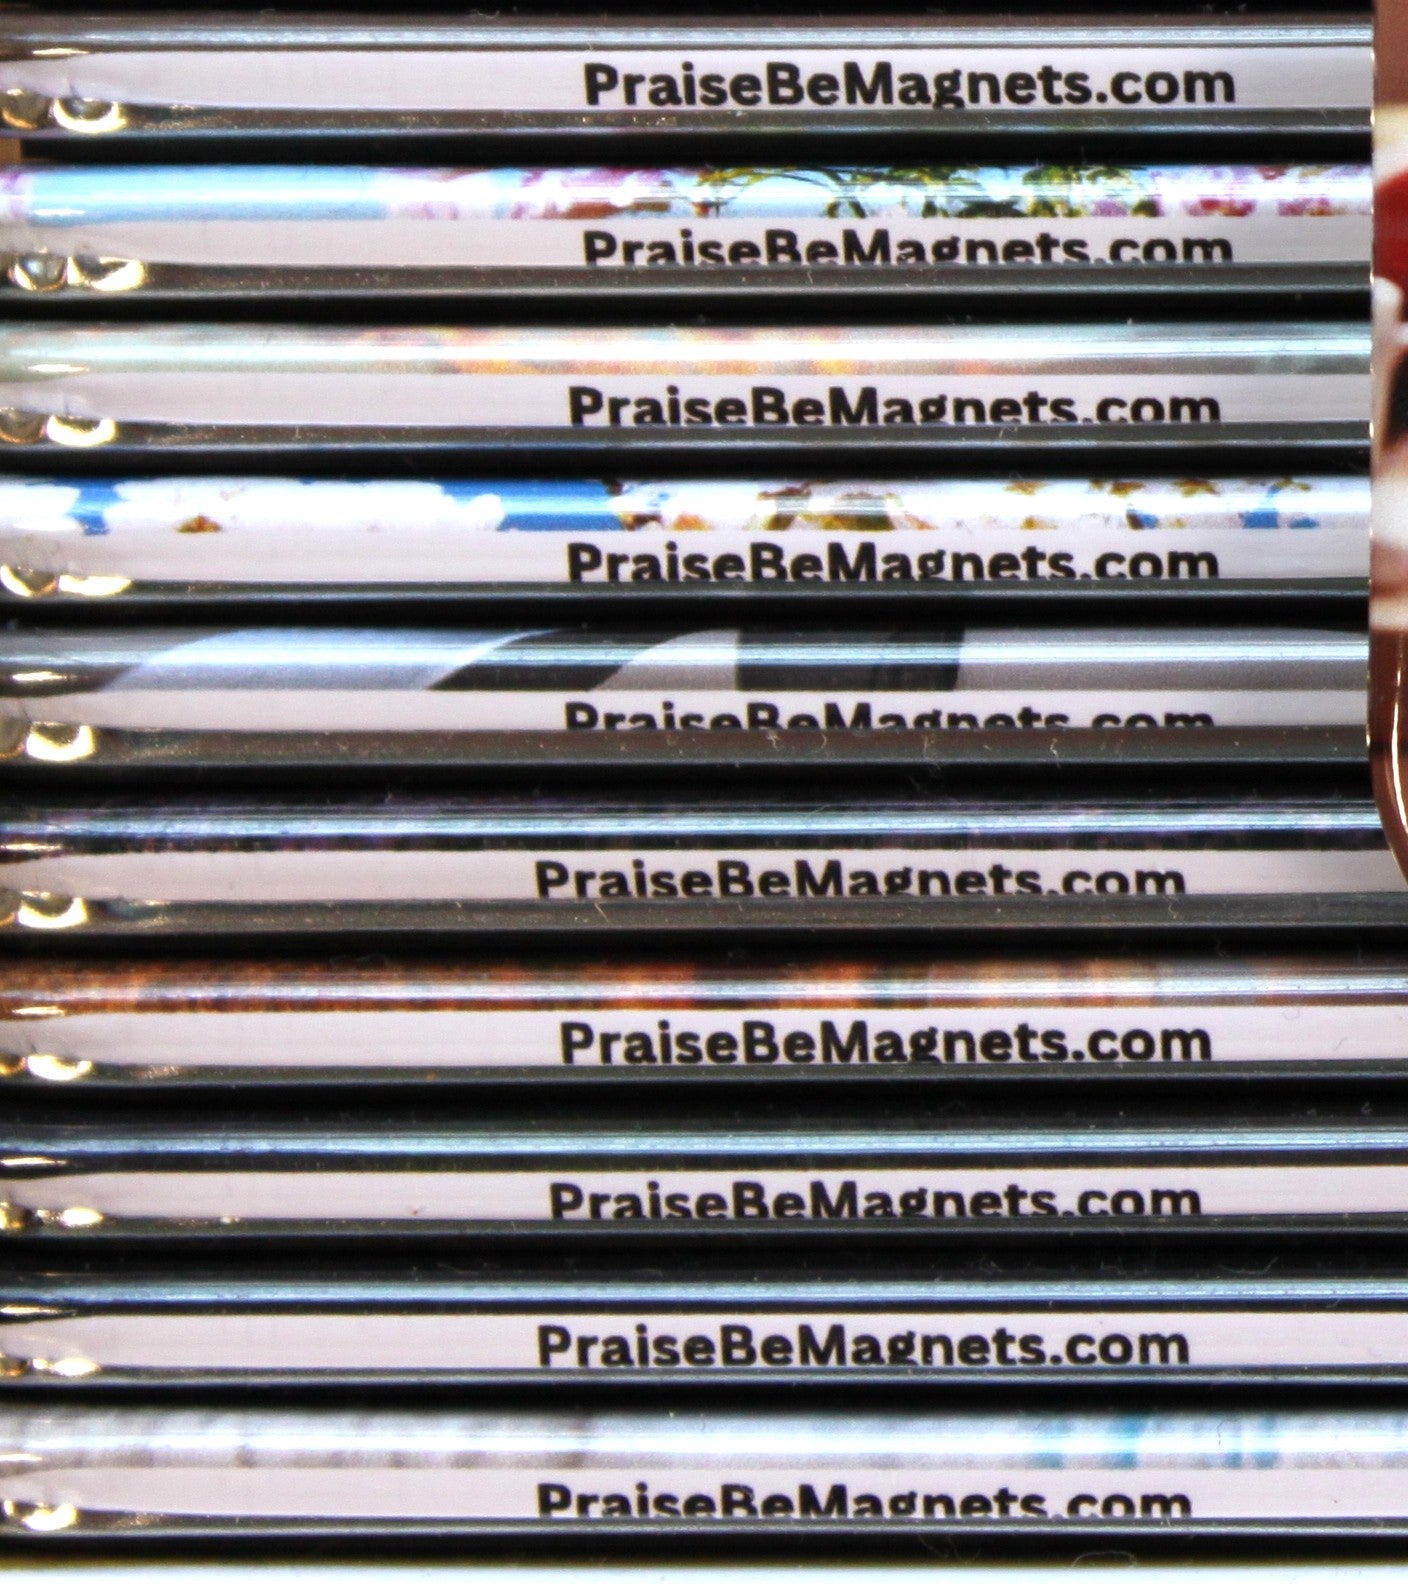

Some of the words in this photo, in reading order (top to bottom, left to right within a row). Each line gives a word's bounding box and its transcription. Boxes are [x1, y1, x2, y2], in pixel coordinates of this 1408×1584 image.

[584, 62, 1235, 110] PraiseBeMagnets.com
[568, 542, 1219, 582] PraiseBeMagnets.com
[560, 1020, 1212, 1064] PraiseBeMagnets.com
[549, 1182, 1202, 1218] PraiseBeMagnets.com
[537, 1326, 1189, 1366] PraiseBeMagnets.com
